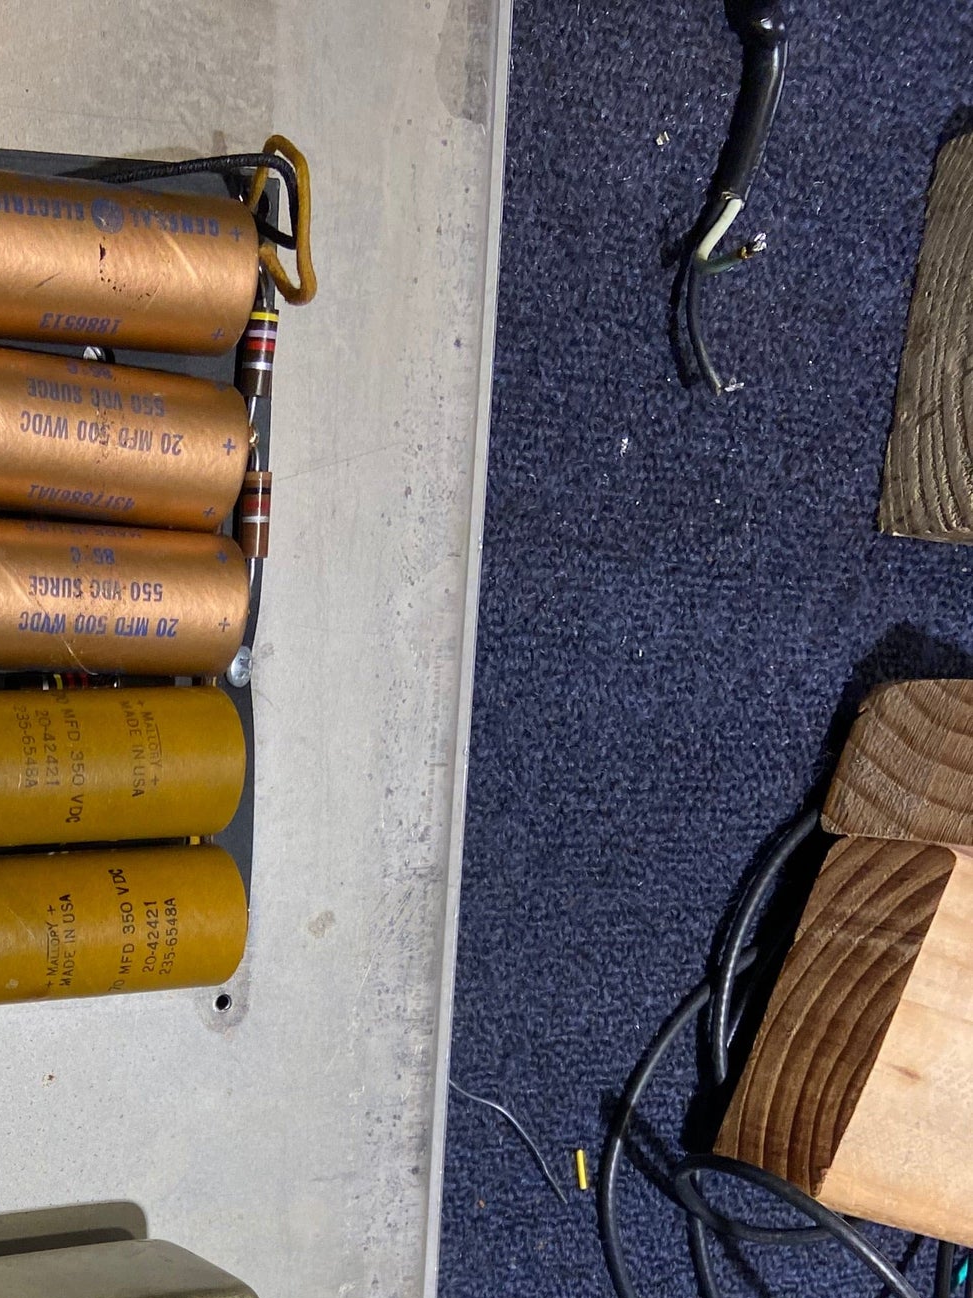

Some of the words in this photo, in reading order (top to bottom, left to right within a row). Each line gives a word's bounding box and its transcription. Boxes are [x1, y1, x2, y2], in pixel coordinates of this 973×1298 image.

[27, 378, 83, 405] SURGE
[20, 411, 69, 444] WVDC
[77, 419, 113, 448] 500
[118, 424, 157, 454] MFD
[161, 431, 184, 457] 20
[28, 575, 83, 598] SURGE
[89, 579, 122, 600] VDC
[130, 581, 163, 602] 550
[17, 610, 66, 635] WVDC
[74, 613, 108, 635] 500
[114, 616, 149, 637] MFD
[156, 617, 179, 638] 20
[60, 708, 81, 742] MFD
[120, 700, 141, 736] MADE
[34, 709, 60, 787] 20-42421
[131, 744, 144, 760] IN
[140, 711, 163, 768] MALLORY
[69, 751, 85, 787] 350
[130, 765, 146, 798] USA
[58, 893, 76, 923] USA
[119, 901, 136, 935] 350
[45, 920, 61, 977] MALLORY
[63, 928, 76, 944] IN
[141, 900, 160, 973] 20-42421
[158, 896, 178, 976] 235-6548A
[58, 950, 76, 987] MADE
[117, 943, 135, 975] MFD
